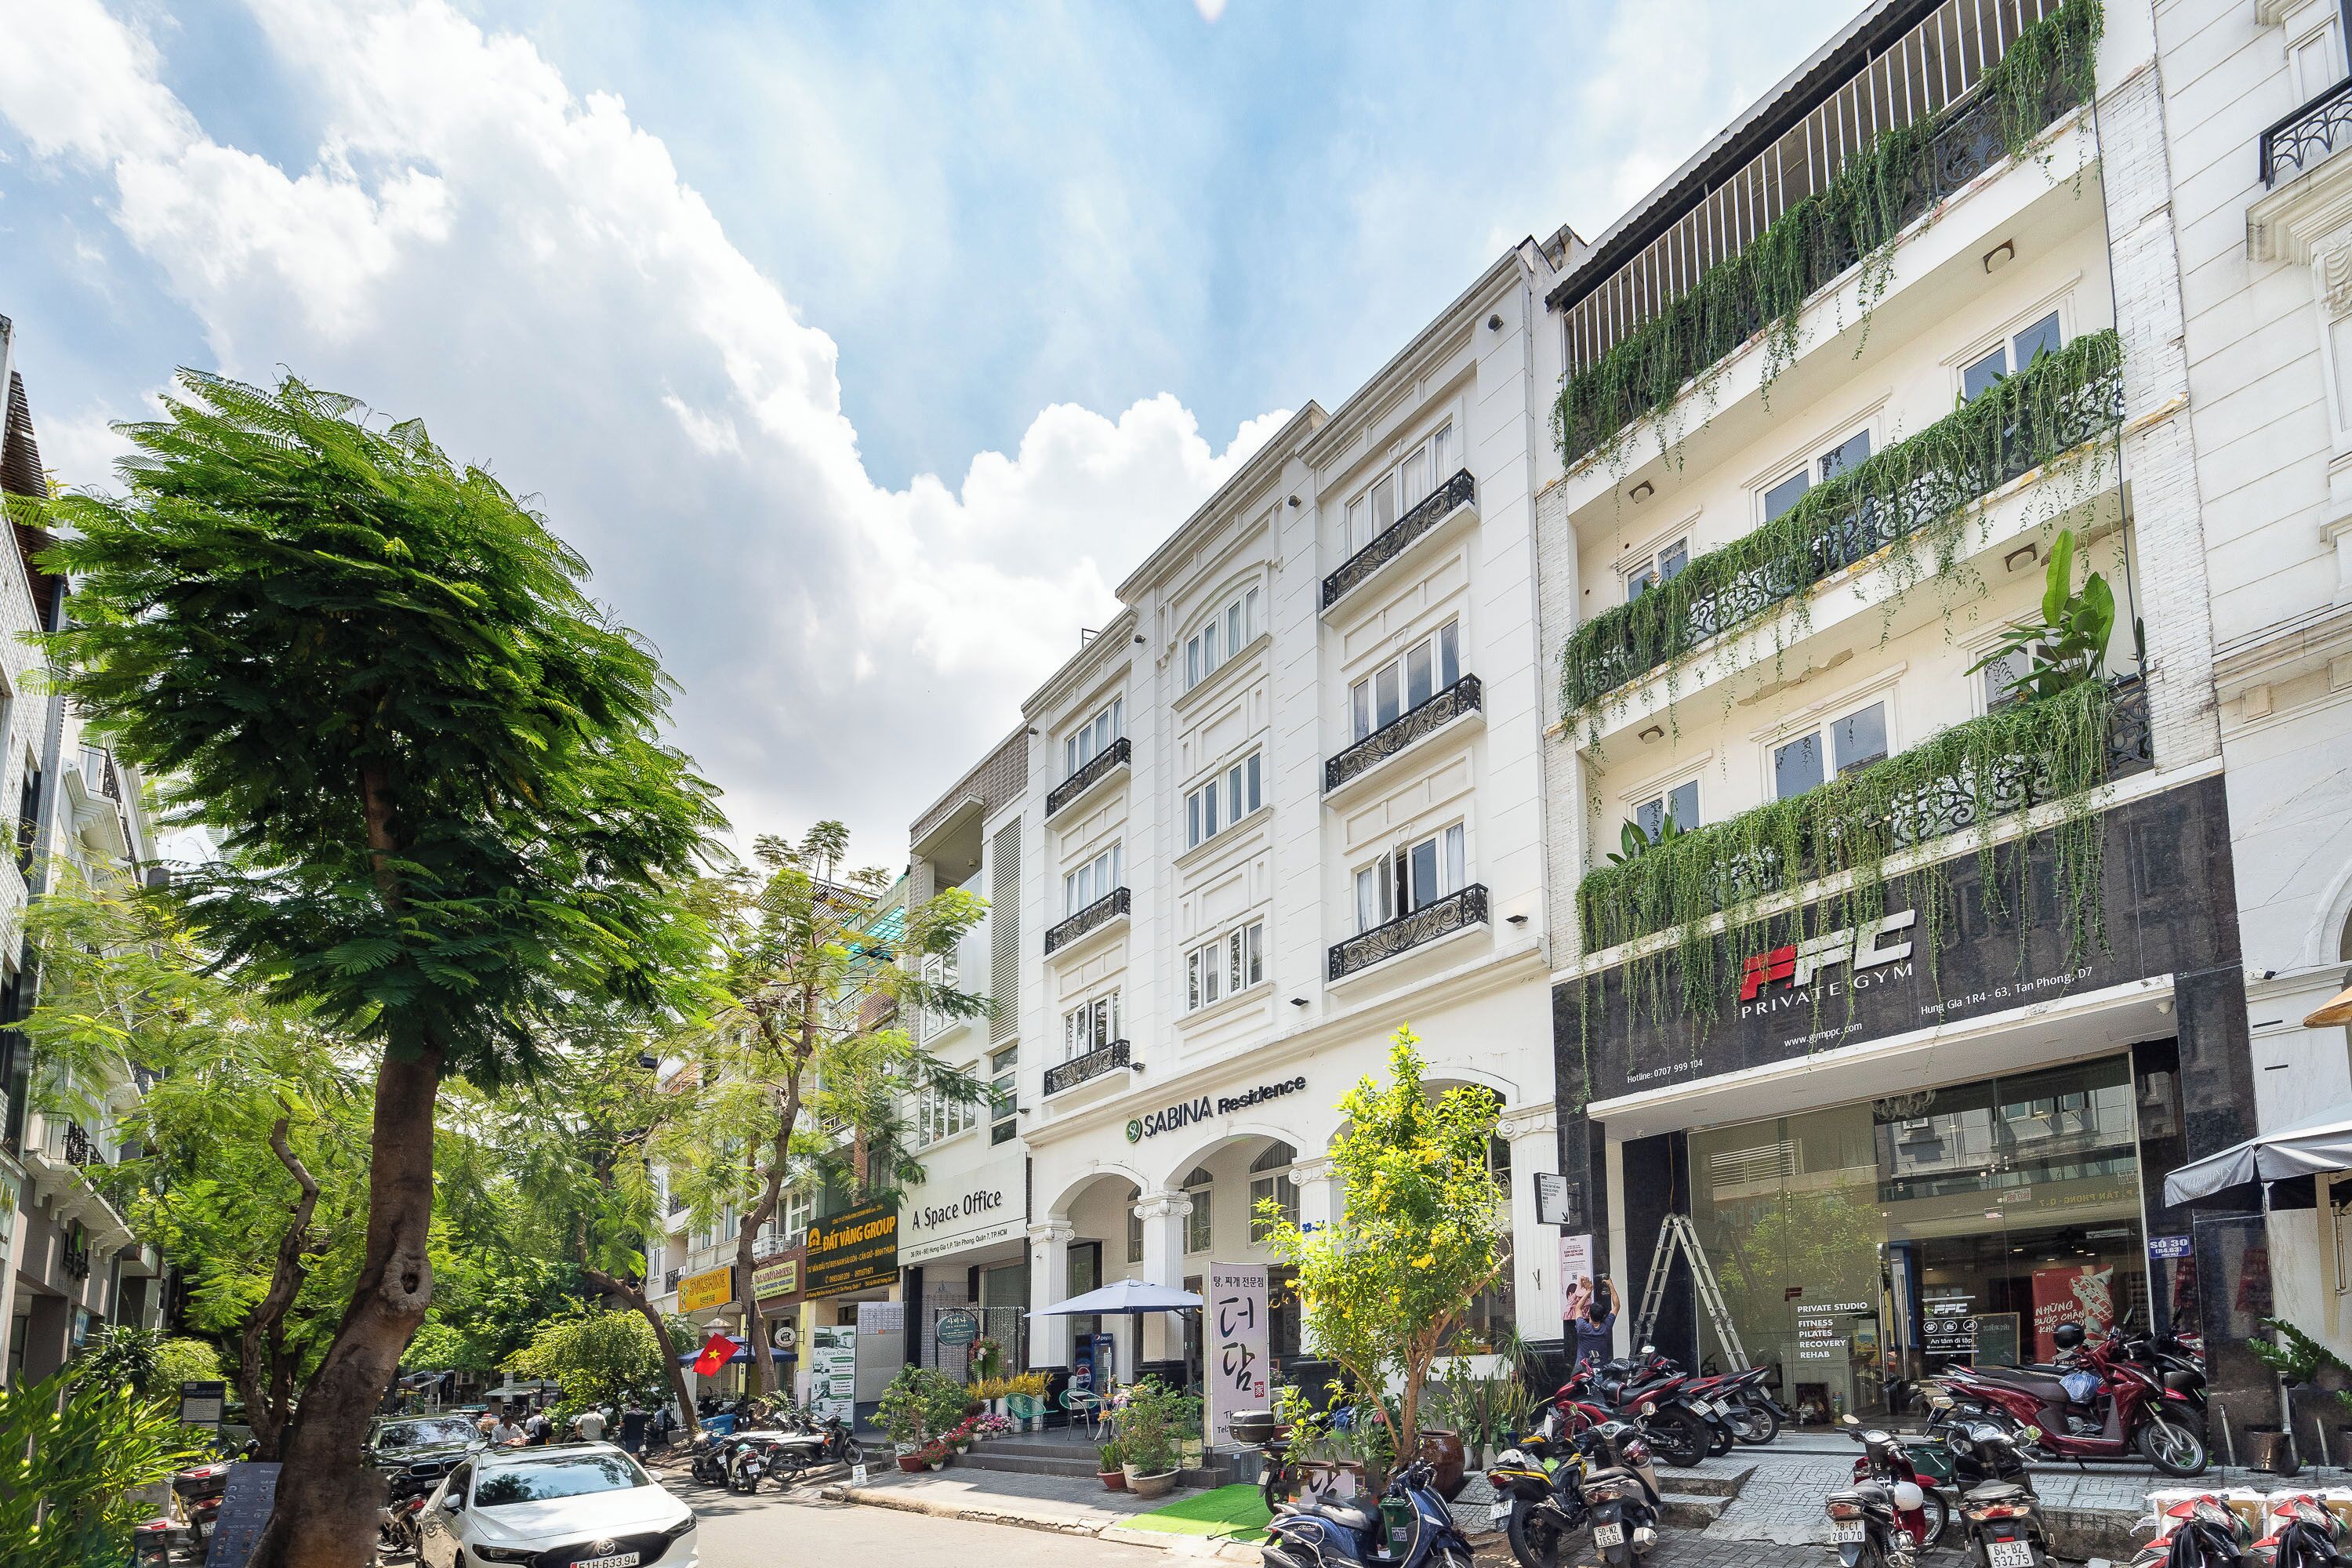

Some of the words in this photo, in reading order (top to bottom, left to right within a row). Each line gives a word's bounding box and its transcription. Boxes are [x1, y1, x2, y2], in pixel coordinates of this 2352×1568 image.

[1741, 981, 1841, 1019] PRIVATE
[1853, 963, 1912, 989] GYM
[1921, 1003, 1944, 1015] Hung
[1947, 998, 1962, 1010] Gia
[1994, 986, 2011, 999] 63,
[2015, 981, 2034, 993] Tan
[2036, 972, 2074, 989] Phong,
[2078, 966, 2092, 978] D7
[1627, 1072, 1653, 1083] Hotline:
[1653, 1065, 1671, 1077] 0707
[1674, 1062, 1688, 1073] 999
[1690, 1058, 1703, 1069] 104
[1144, 1096, 1213, 1137] SABINA
[1218, 1076, 1306, 1114] Residence
[912, 1210, 920, 1230] A
[924, 1203, 959, 1229] Space
[963, 1190, 1002, 1215] Office
[822, 1229, 840, 1251] ĐẤT
[840, 1226, 863, 1247] VÀNG
[864, 1215, 896, 1240] GROUP
[2150, 1239, 2166, 1248] SỐ
[2170, 1239, 2187, 1247] 30
[690, 1270, 726, 1296] SUNSHINE
[1213, 1276, 1223, 1287] 탕,
[1225, 1276, 1240, 1287] 찌개
[1242, 1276, 1264, 1288] 전문점
[1797, 1304, 1831, 1313] PRIVATE
[1834, 1301, 1867, 1311] STUDIO
[2035, 1301, 2073, 1316] NHỮNG
[1798, 1319, 1833, 1327] FITNESS
[2034, 1314, 2058, 1327] BƯỚC
[2060, 1309, 2085, 1321] CHÂN
[1799, 1340, 1846, 1348] RECOVERY
[1598, 1526, 1617, 1537] 50-N2
[1835, 1522, 1858, 1531] 78-C1
[1833, 1531, 1862, 1541] 280.70
[1994, 1543, 2024, 1555] 64-B2
[1994, 1554, 2030, 1566] 532.75
